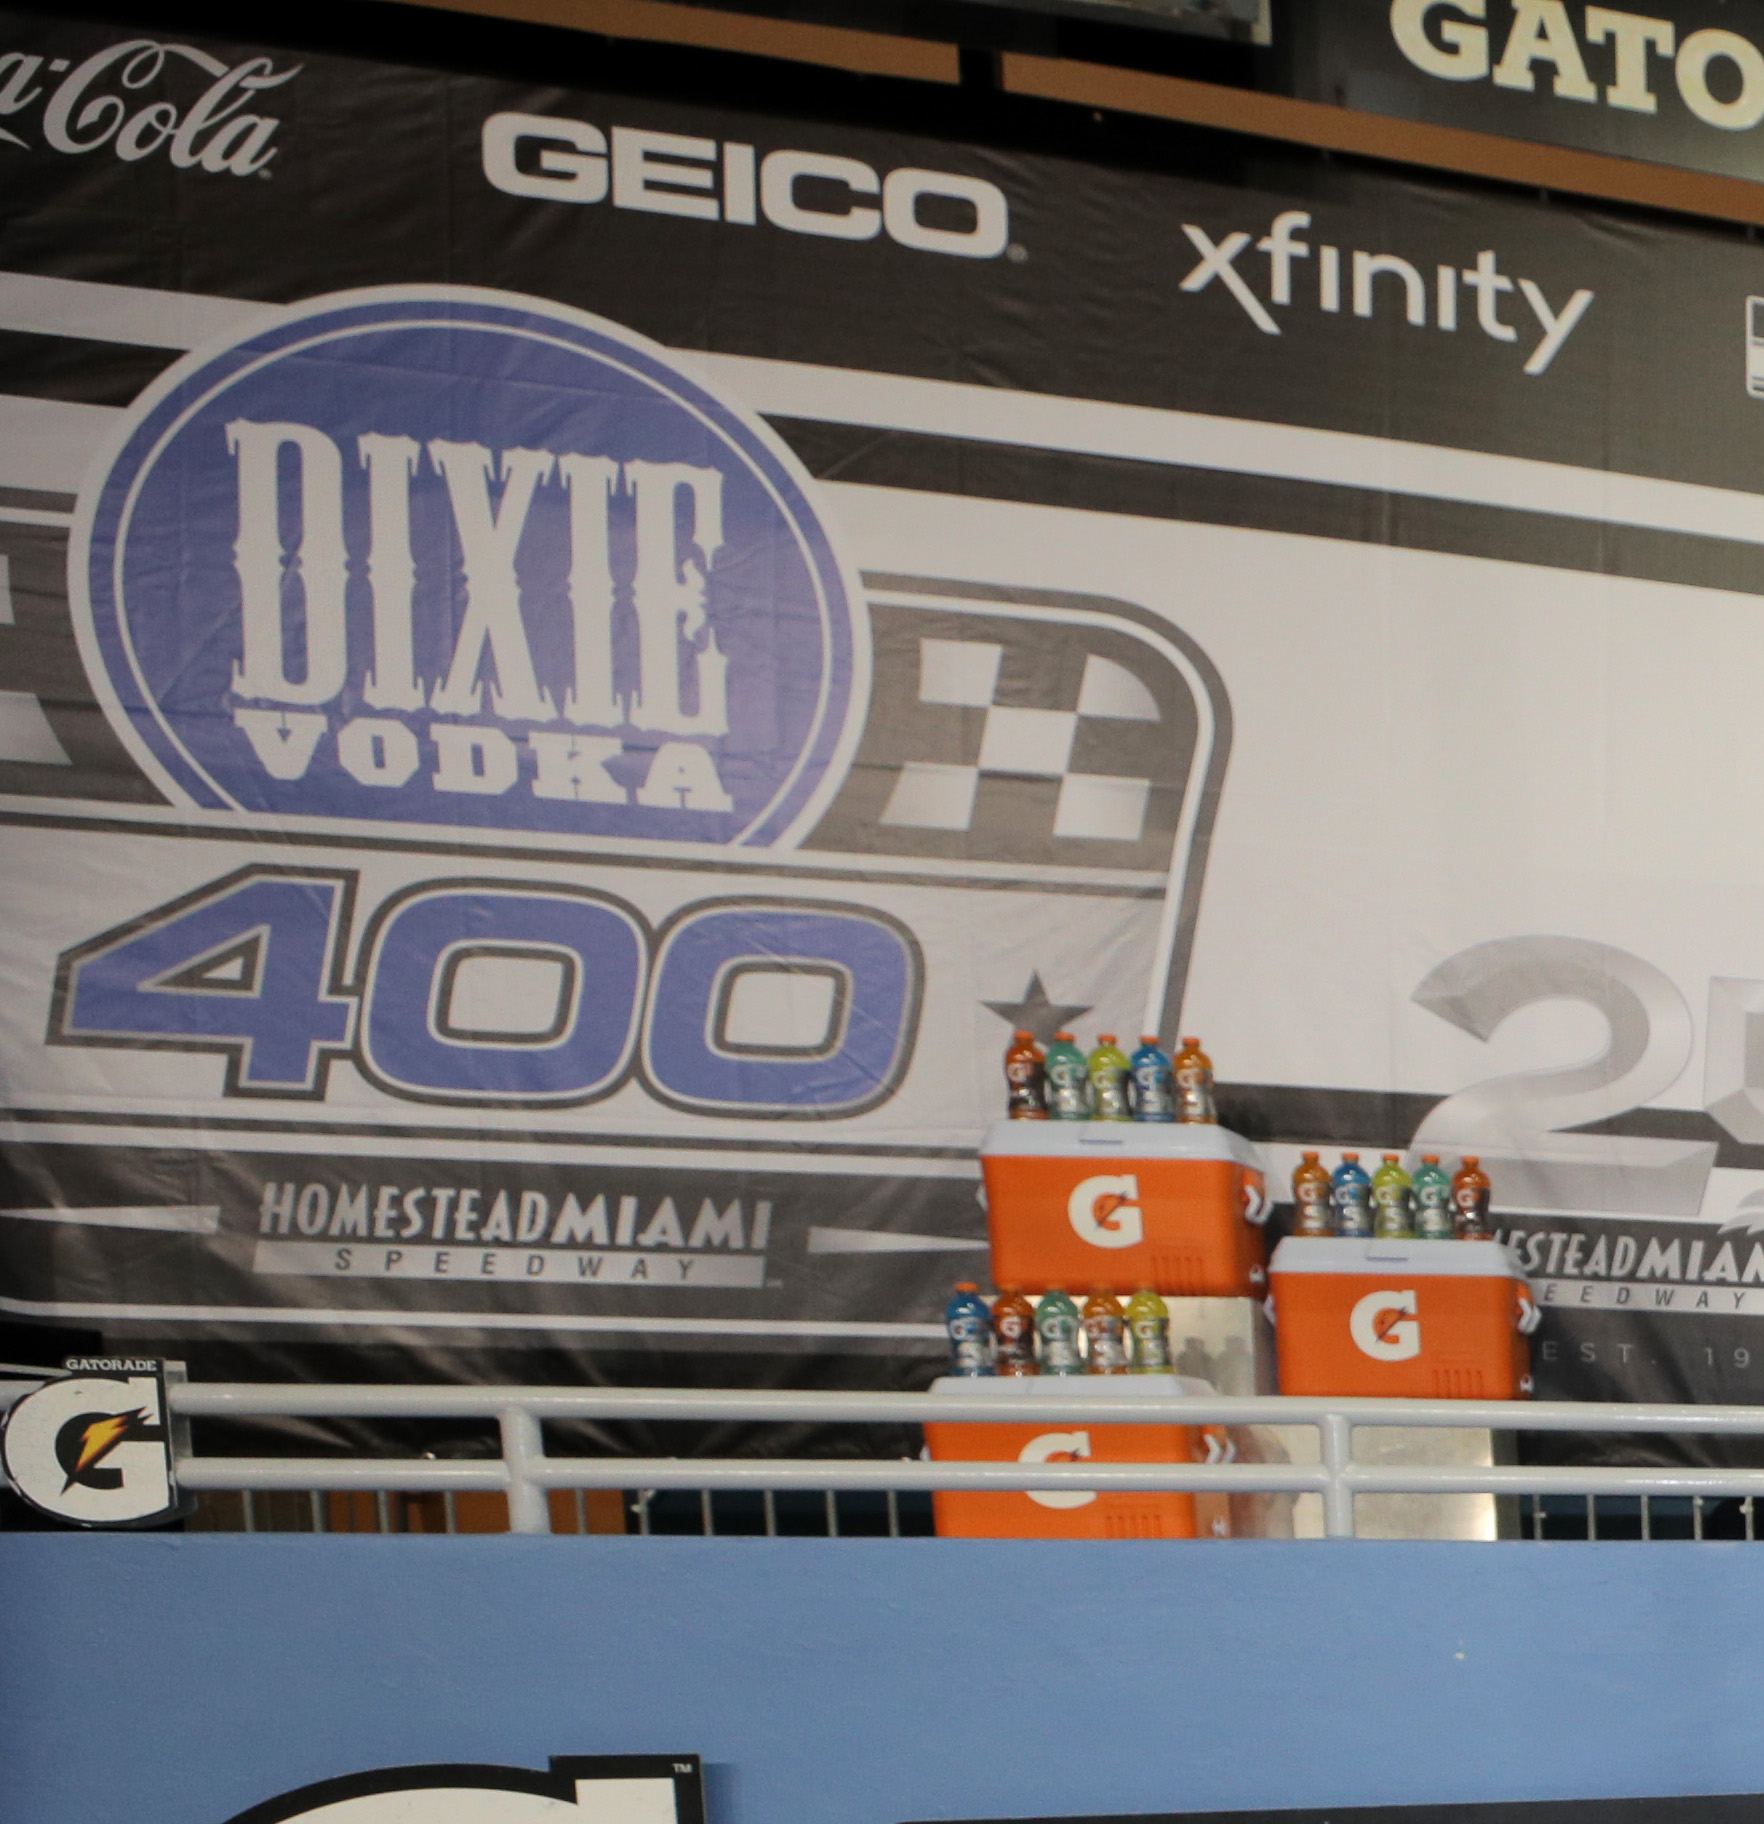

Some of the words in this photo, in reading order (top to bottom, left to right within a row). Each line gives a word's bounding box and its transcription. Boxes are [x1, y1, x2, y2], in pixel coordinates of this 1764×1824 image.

[0, 38, 303, 178] a-Cola
[481, 112, 1008, 258] GEICO
[1179, 211, 1594, 374] xfinity
[225, 417, 729, 735] DIXIE
[235, 708, 733, 812] VODKA
[45, 863, 925, 1119] 400
[259, 1184, 771, 1250] HOMESTEADMIAMI
[335, 1250, 694, 1279] SPEEDWAY
[1544, 1285, 1746, 1309] EEDWAY
[66, 1359, 157, 1371] GATORADE
[1543, 1342, 1657, 1365] EST.
